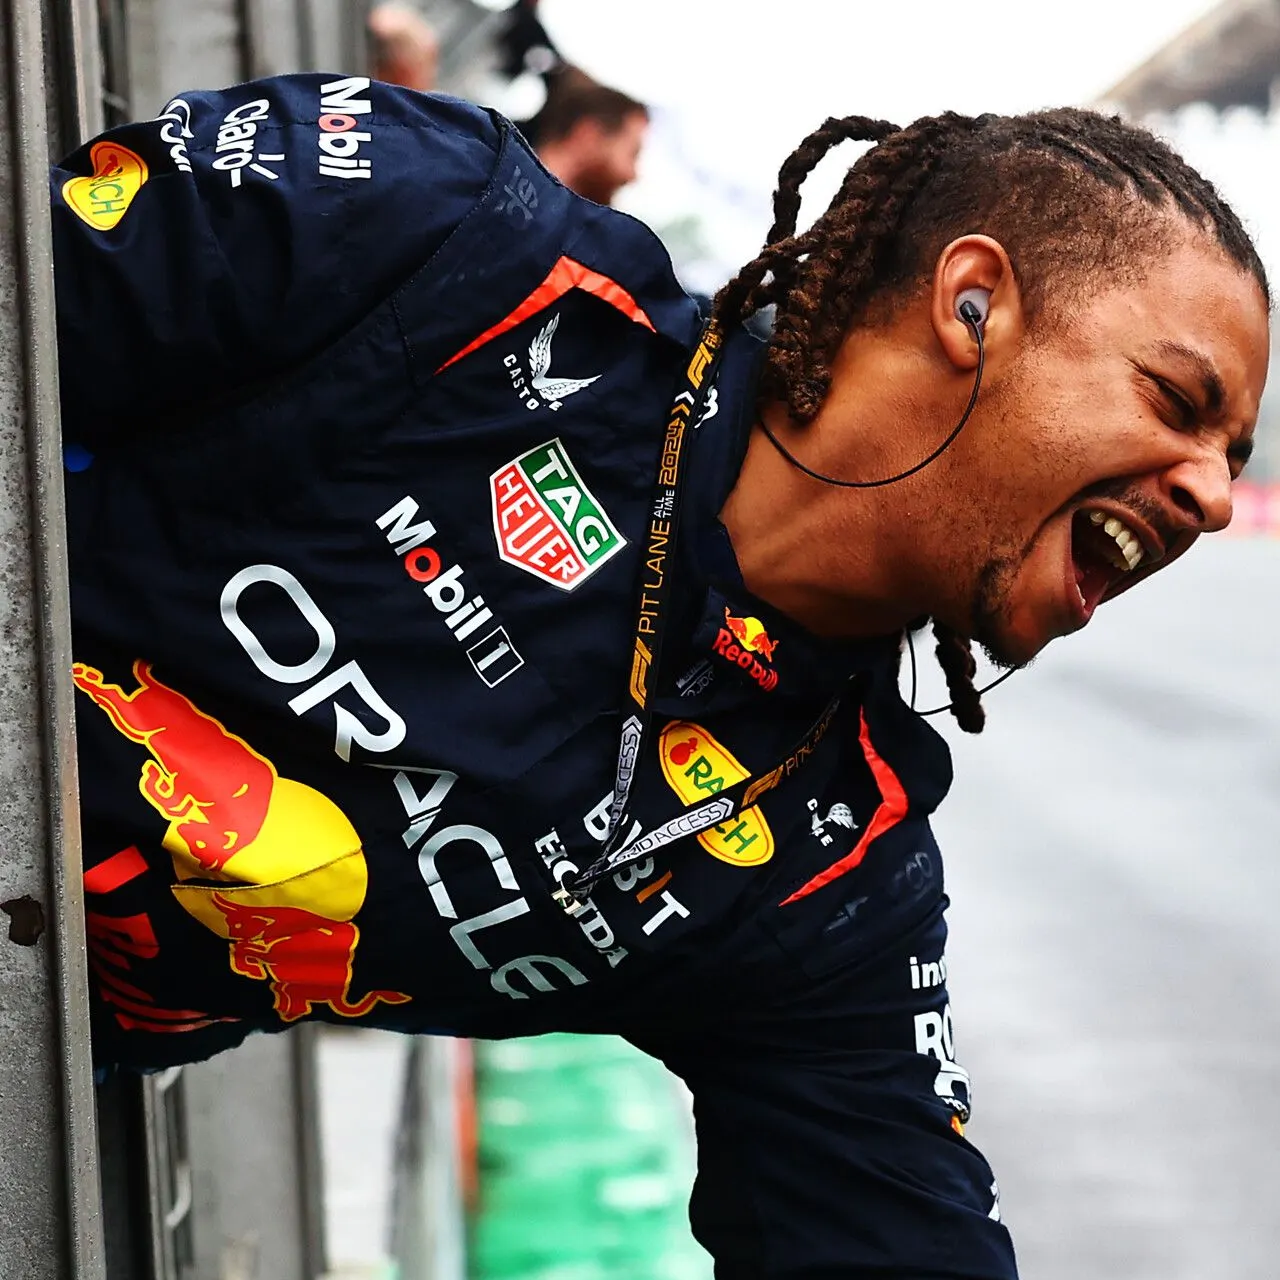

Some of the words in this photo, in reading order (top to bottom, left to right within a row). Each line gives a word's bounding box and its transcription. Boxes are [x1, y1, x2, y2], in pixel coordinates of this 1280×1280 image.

[319, 77, 372, 179] Mobil
[503, 353, 563, 411] CASTOE
[658, 417, 686, 486] 2024
[494, 470, 581, 583] HEUER
[531, 448, 614, 562] TAG
[653, 496, 665, 518] ALL
[662, 489, 675, 519] TIME
[375, 495, 494, 642] Mobil
[644, 520, 671, 589] LANE
[638, 592, 660, 634] PIT
[220, 564, 590, 1000] ORACLE
[615, 732, 640, 805] ACCESS
[656, 803, 722, 843] ACCESS
[685, 755, 759, 855] RAH
